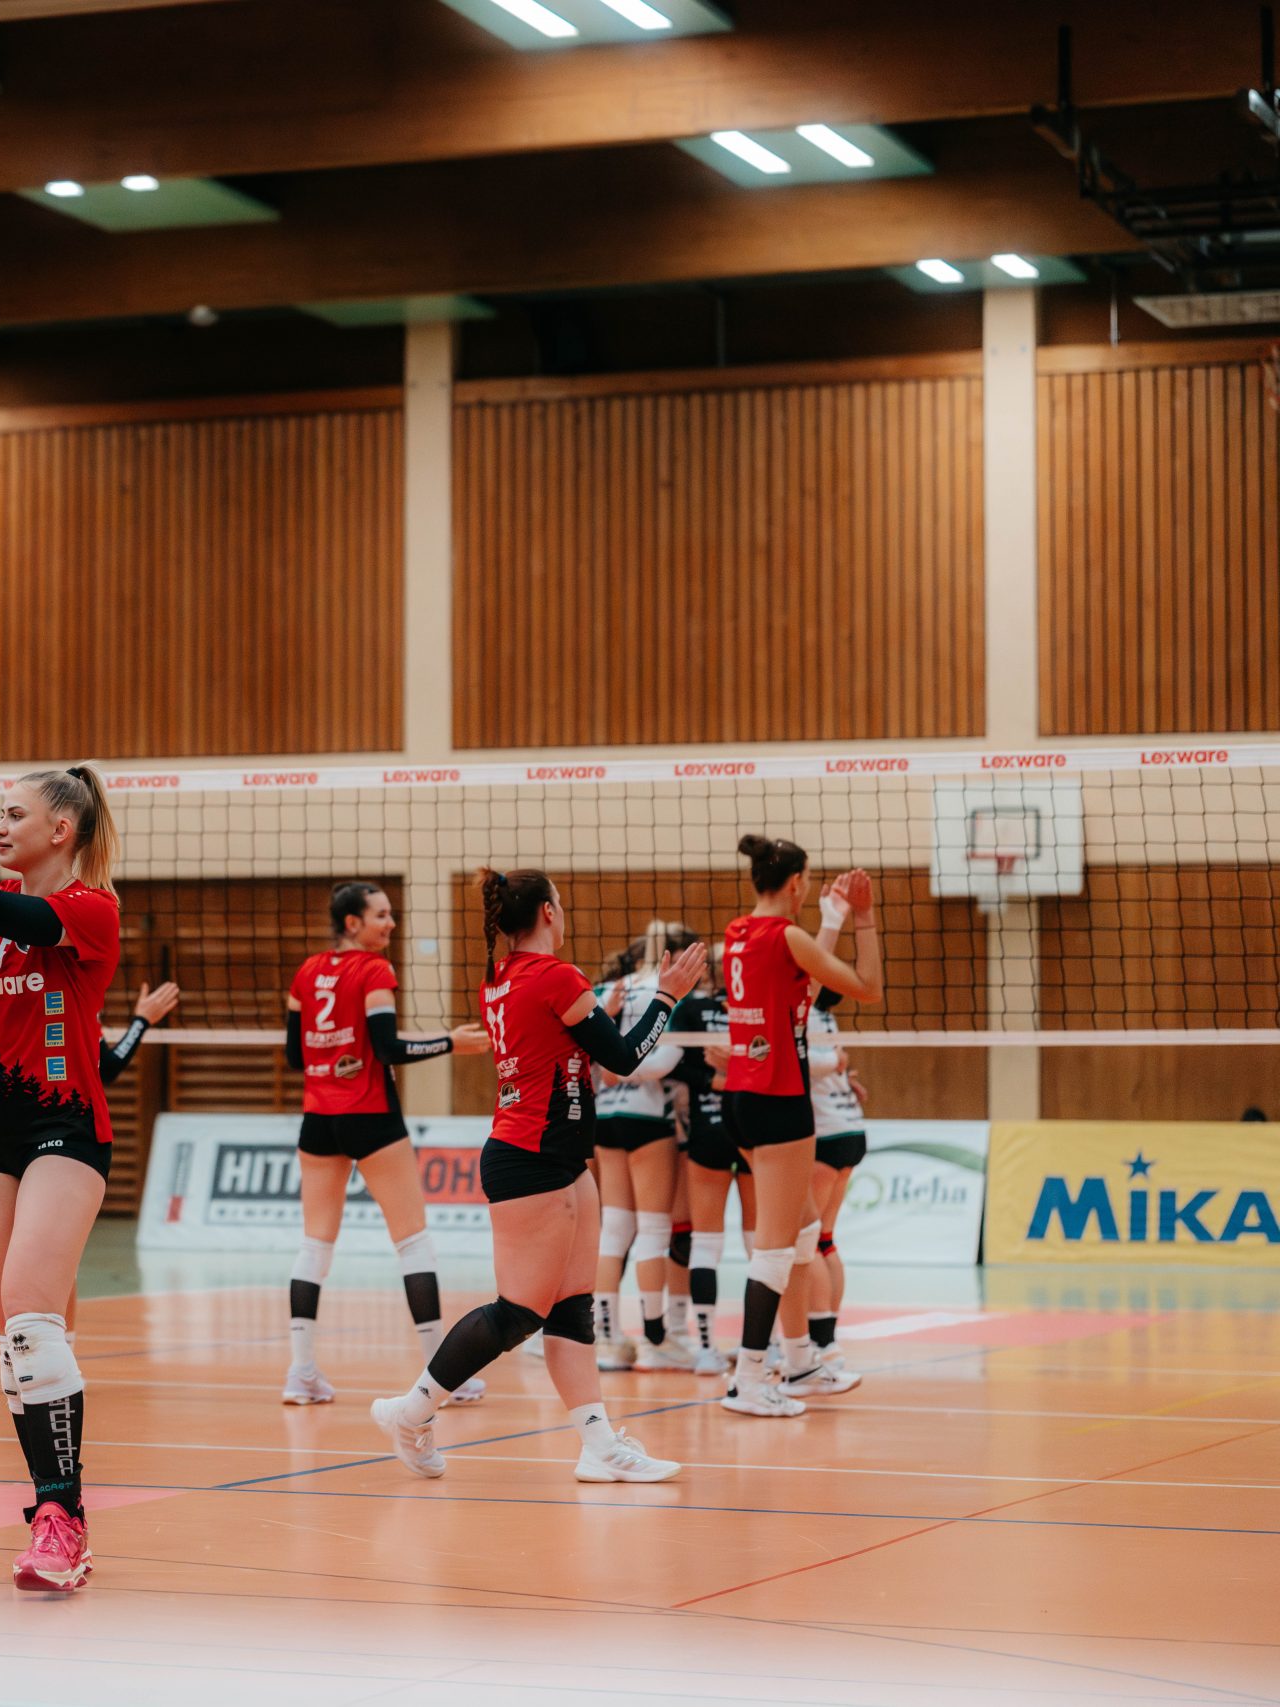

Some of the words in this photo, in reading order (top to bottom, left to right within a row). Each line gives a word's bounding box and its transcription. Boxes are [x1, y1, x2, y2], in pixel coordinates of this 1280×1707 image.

[980, 754, 1067, 771] Lexware
[1140, 749, 1229, 766] Lexware
[527, 766, 606, 781] Lexware
[674, 762, 756, 777] Lexware
[825, 758, 910, 774] Lexware
[107, 775, 180, 789] Lexware
[242, 772, 318, 787] Lexware
[383, 769, 460, 784] Lexware
[731, 956, 745, 1001] 8
[314, 989, 336, 1031] 2
[635, 1010, 668, 1060] Lexware
[888, 1176, 968, 1206] Reha
